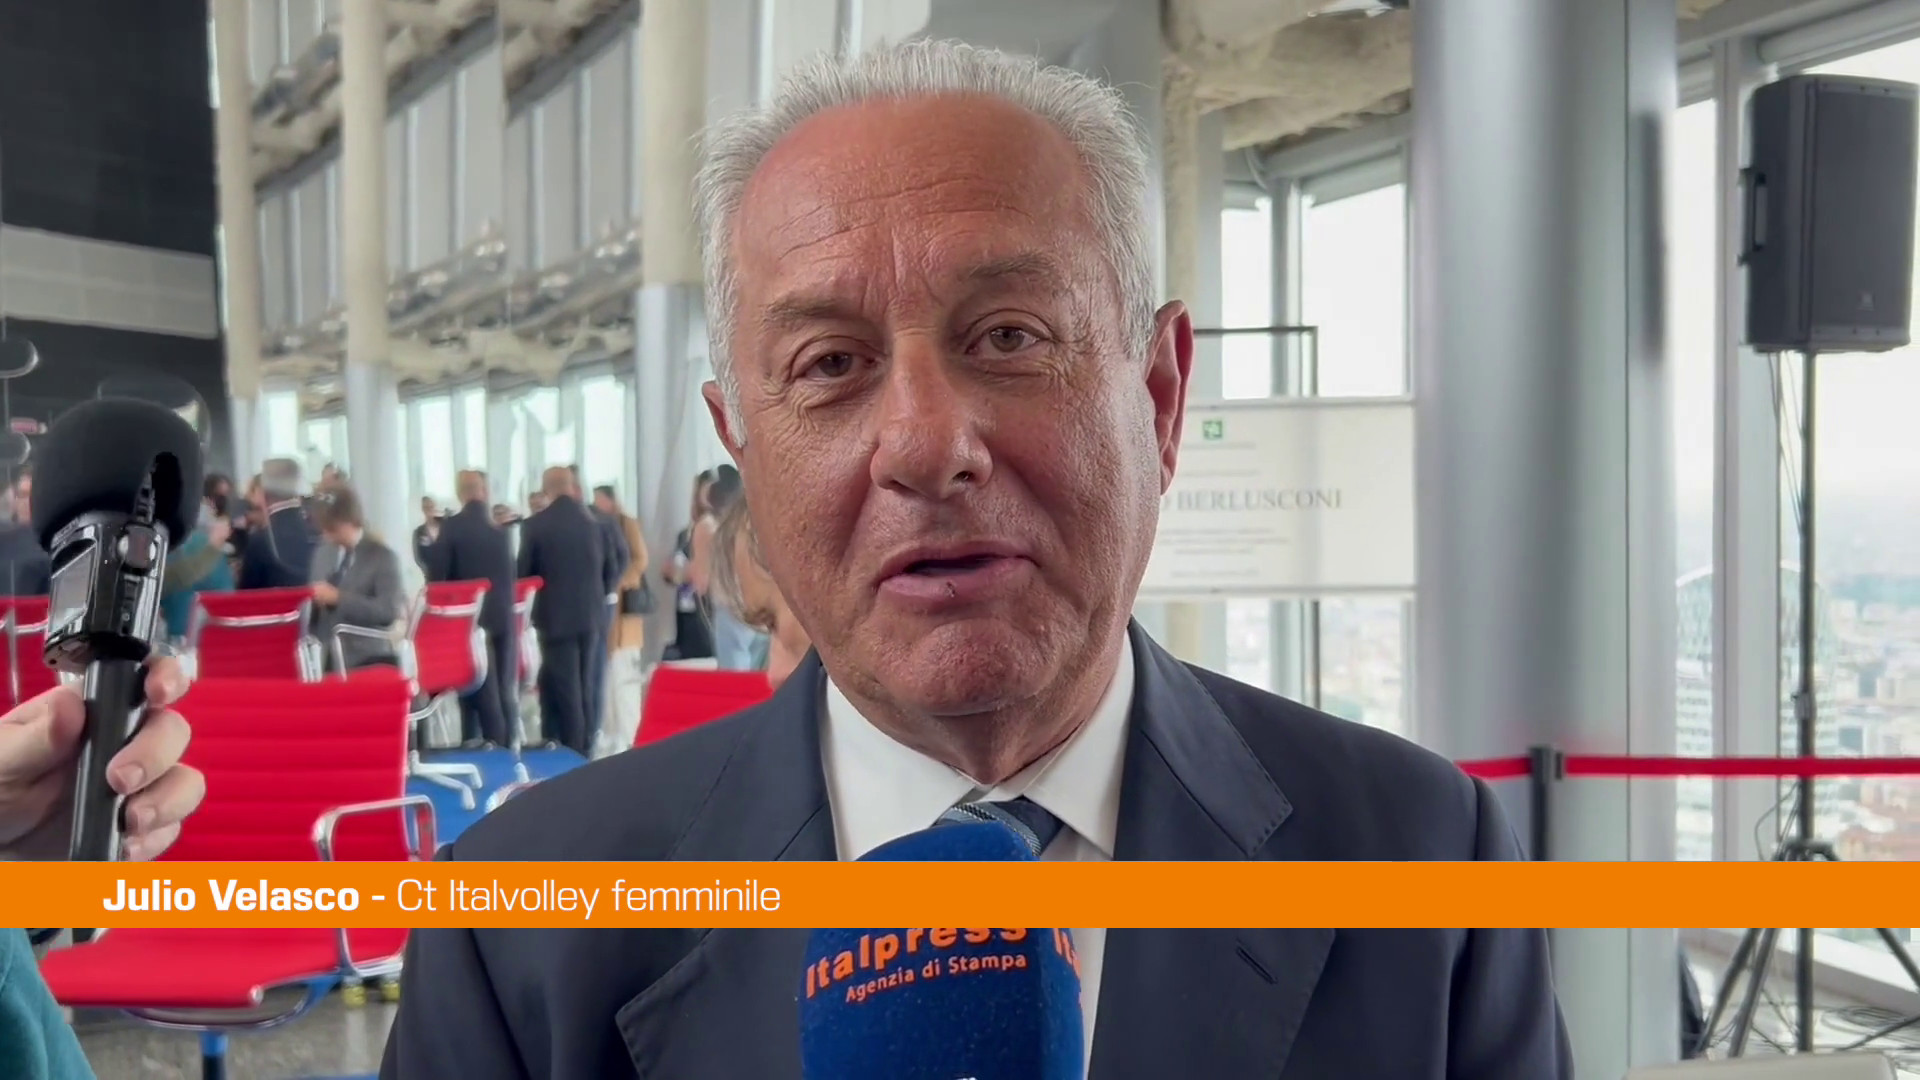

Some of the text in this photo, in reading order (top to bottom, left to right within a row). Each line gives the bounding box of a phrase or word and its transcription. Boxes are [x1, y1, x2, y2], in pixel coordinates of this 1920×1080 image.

[1177, 488, 1342, 511] BERLUSCONI
[806, 928, 1028, 998] Italpress
[845, 954, 1028, 1003] Agenzia di Stampa
